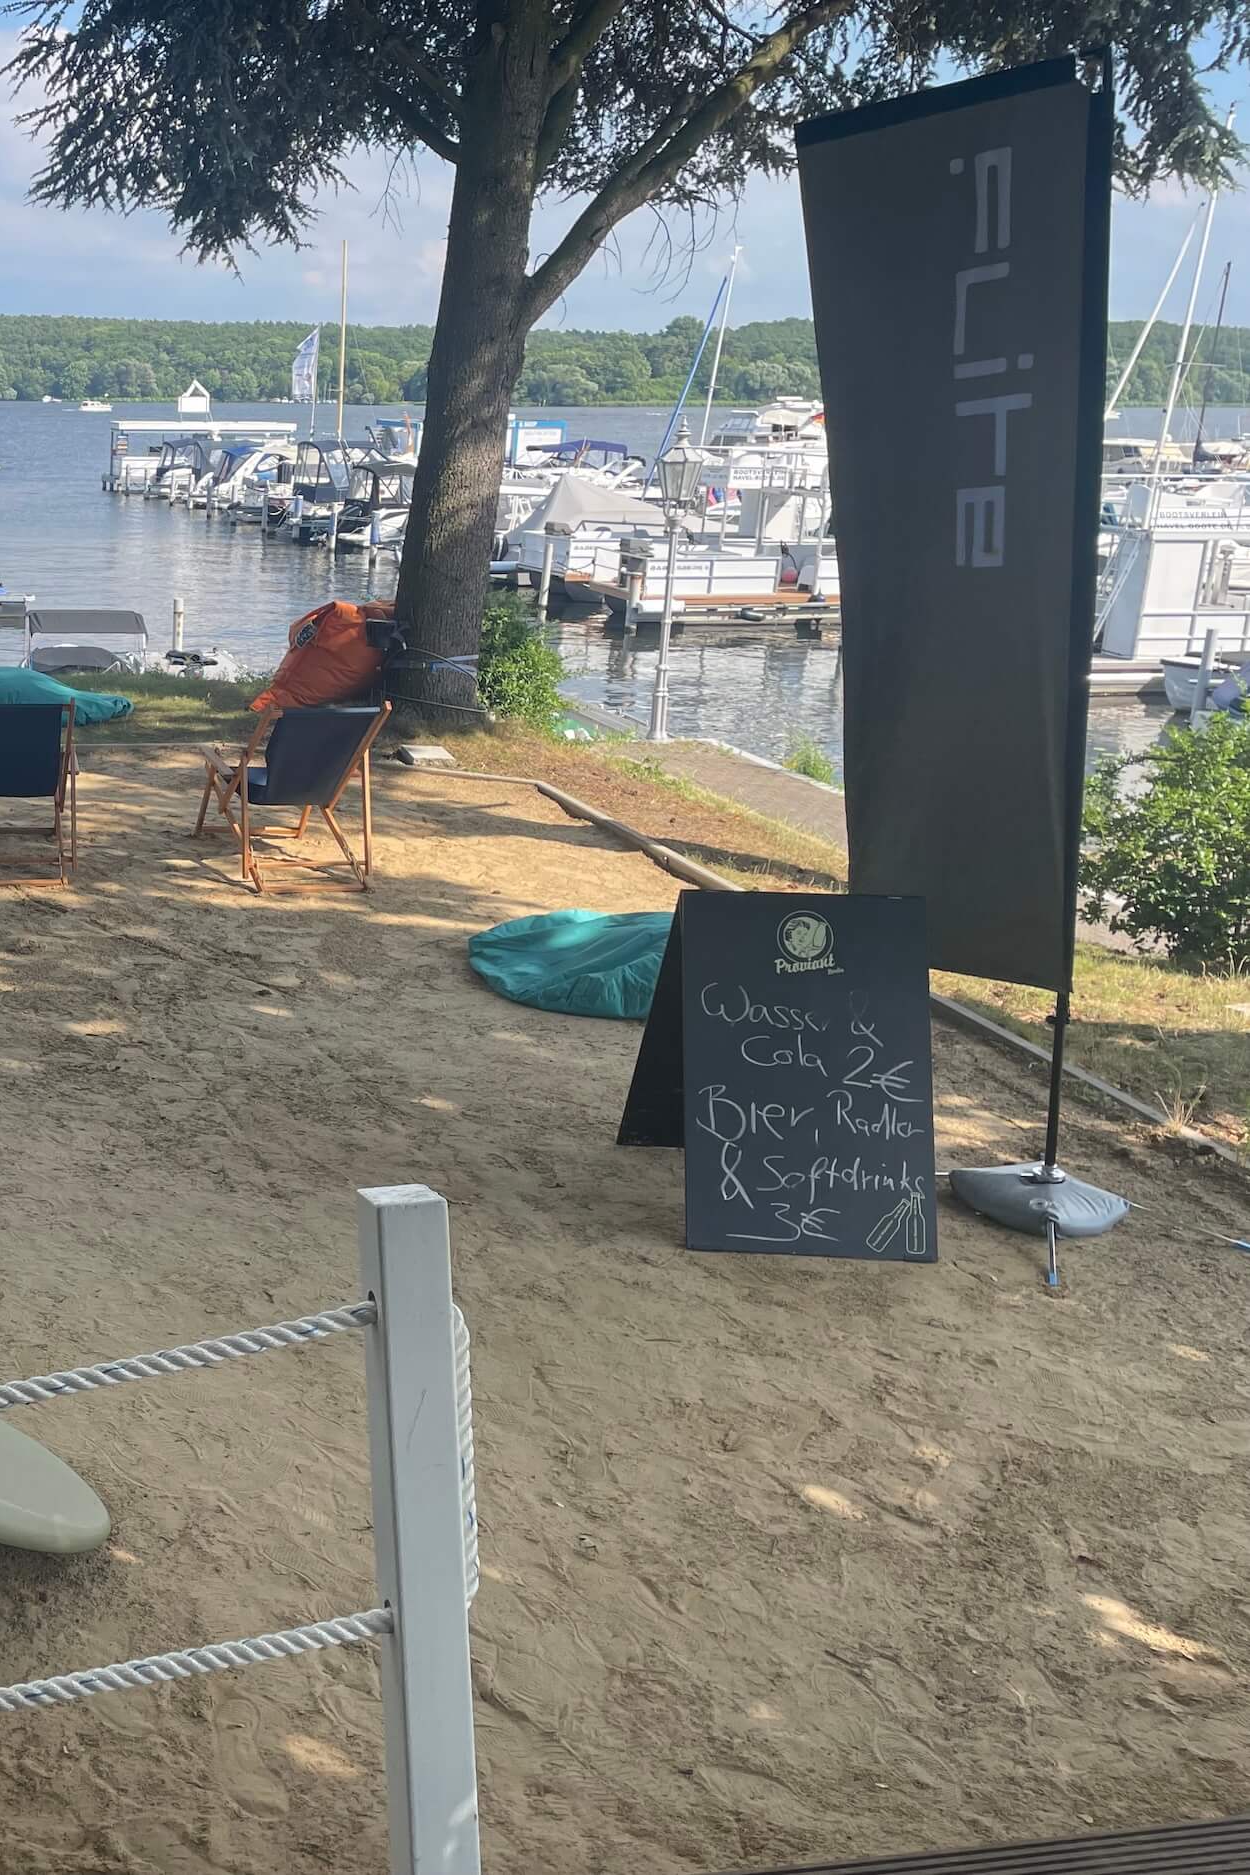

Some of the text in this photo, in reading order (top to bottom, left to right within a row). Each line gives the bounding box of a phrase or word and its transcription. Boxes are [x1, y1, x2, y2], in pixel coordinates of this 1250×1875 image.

[774, 953, 836, 975] Proviant
[741, 1033, 924, 1102] Cola 2€
[826, 1089, 925, 1140] Radler
[721, 1141, 927, 1209] & Softdrinks
[726, 1202, 842, 1241] 3€
